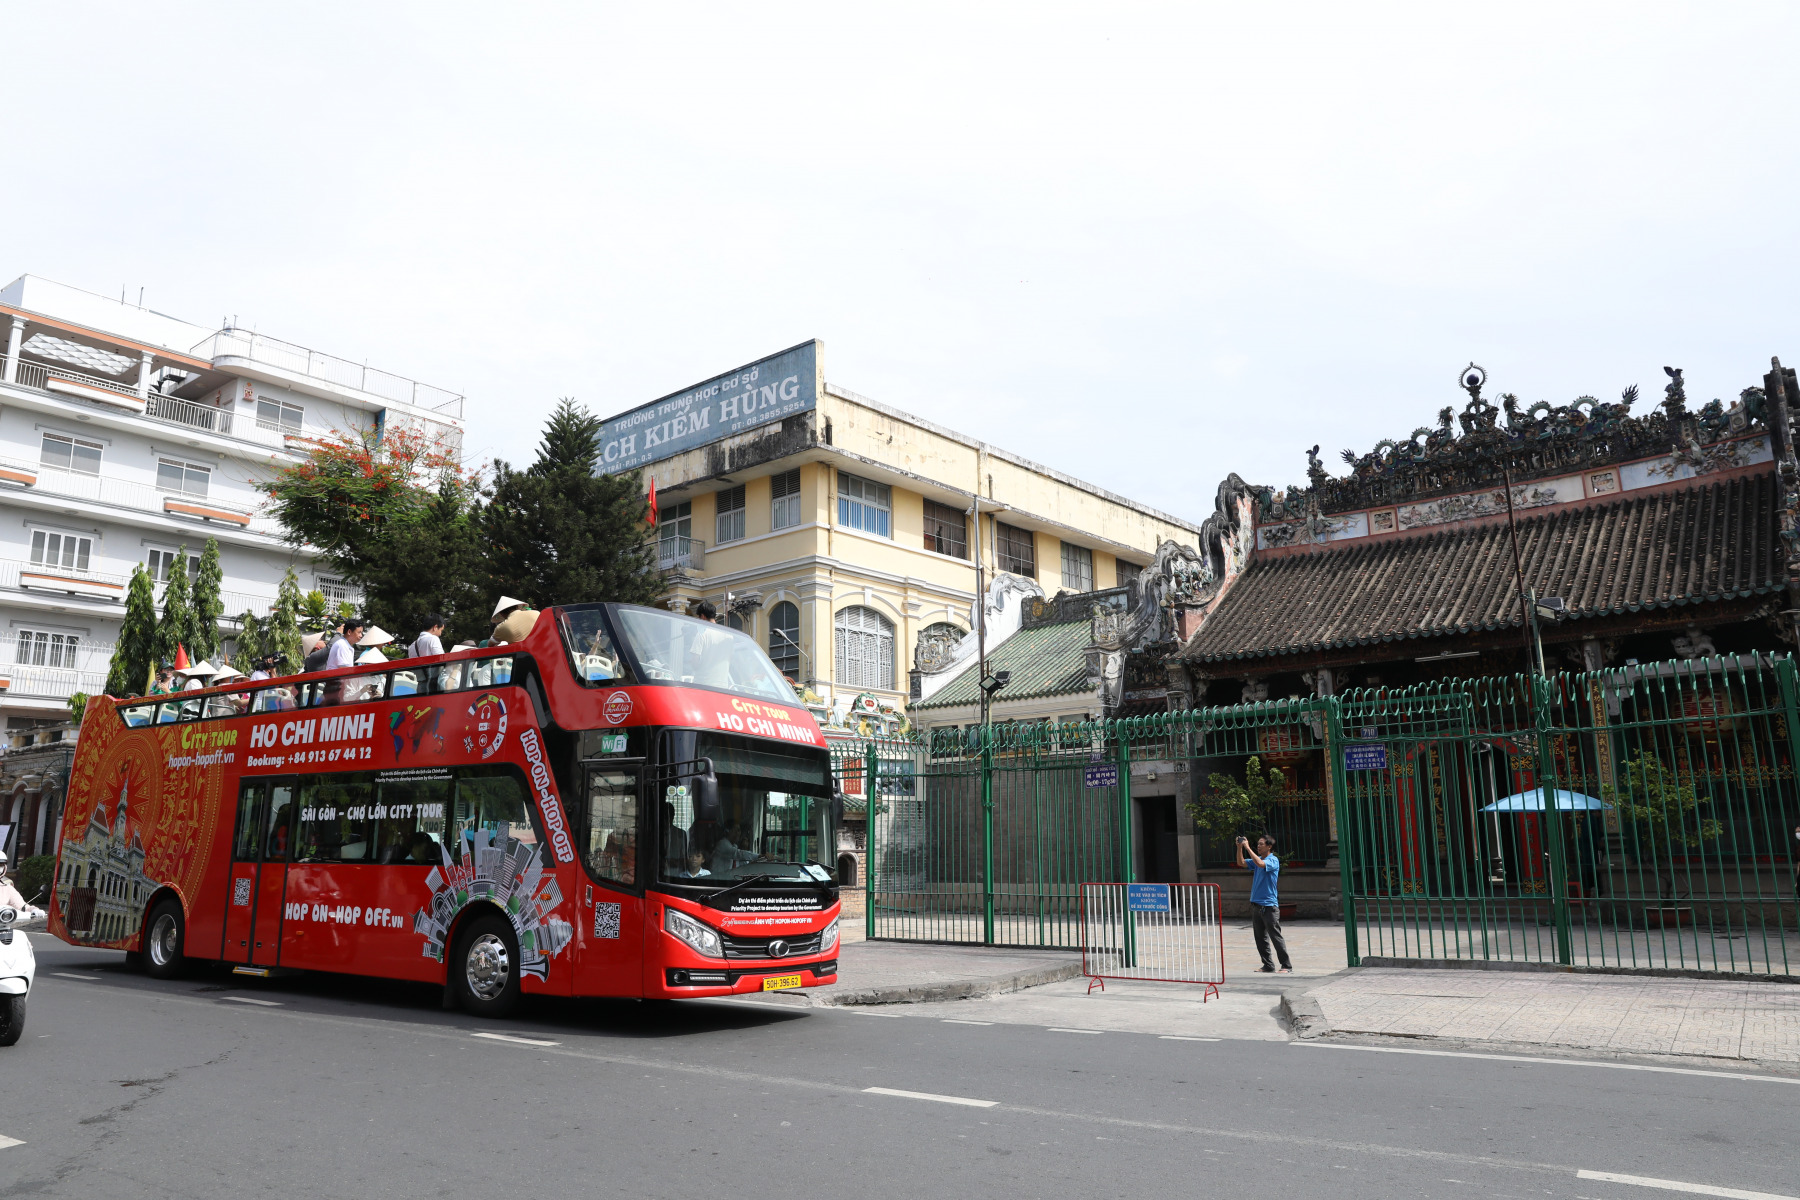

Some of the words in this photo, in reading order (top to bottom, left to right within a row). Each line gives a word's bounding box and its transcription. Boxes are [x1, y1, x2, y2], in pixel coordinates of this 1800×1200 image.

[614, 407, 655, 432] TRƯỜNG
[657, 396, 693, 417] TRUNG
[695, 385, 719, 403] HỌC
[721, 378, 739, 393] CƠ
[741, 366, 759, 384] SỞ
[643, 404, 711, 450] KIẾM
[719, 374, 800, 423] HÙNG
[746, 400, 805, 425] 08.3855.5254
[762, 706, 791, 721] TOUR
[211, 730, 238, 747] TOUR
[250, 723, 278, 748] HO
[281, 719, 316, 746] CHI
[319, 713, 376, 742] MINH
[716, 712, 744, 731] HO
[746, 717, 776, 737] CHI
[776, 723, 816, 744] MINH
[1363, 728, 1375, 737] 710
[168, 750, 235, 770] hopon-hopoff.vn
[247, 754, 285, 768] Booking:
[287, 752, 305, 764] +84
[308, 750, 326, 762] 913
[328, 749, 341, 761] 67
[343, 747, 356, 760] 44
[359, 747, 371, 759] 12
[301, 805, 316, 822] SÀI
[318, 803, 336, 821] GÒN
[347, 804, 366, 823] CHỢ
[368, 802, 387, 820] LỚN
[390, 804, 413, 819] CITY
[416, 803, 443, 819] TOUR
[285, 902, 309, 921] HOP
